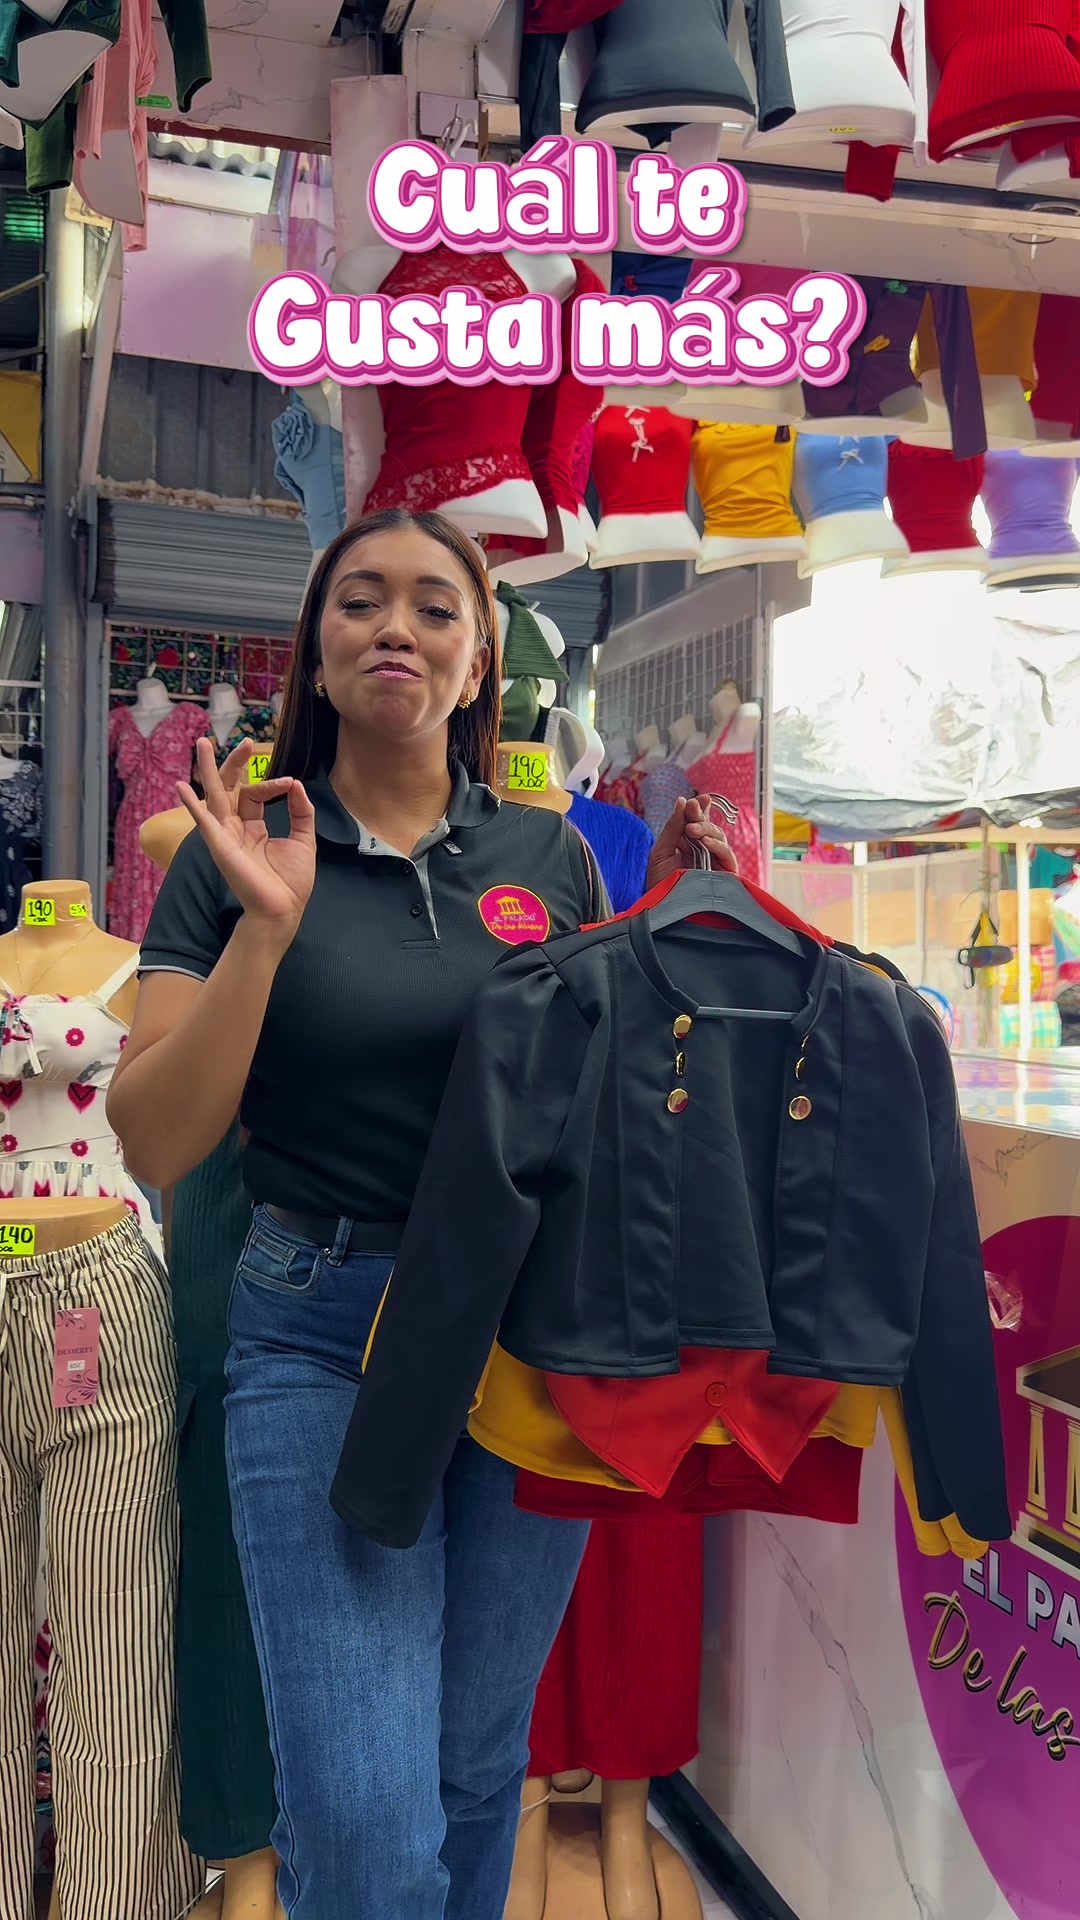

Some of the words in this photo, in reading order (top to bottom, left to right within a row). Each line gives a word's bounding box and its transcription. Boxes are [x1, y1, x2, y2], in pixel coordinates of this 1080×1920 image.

[509, 754, 545, 779] 190
[28, 899, 53, 917] 190
[503, 914, 536, 922] PALACIO
[0, 1225, 33, 1244] 140
[961, 1547, 1014, 1616] EL
[923, 1590, 993, 1693] De
[996, 1645, 1080, 1761] las
